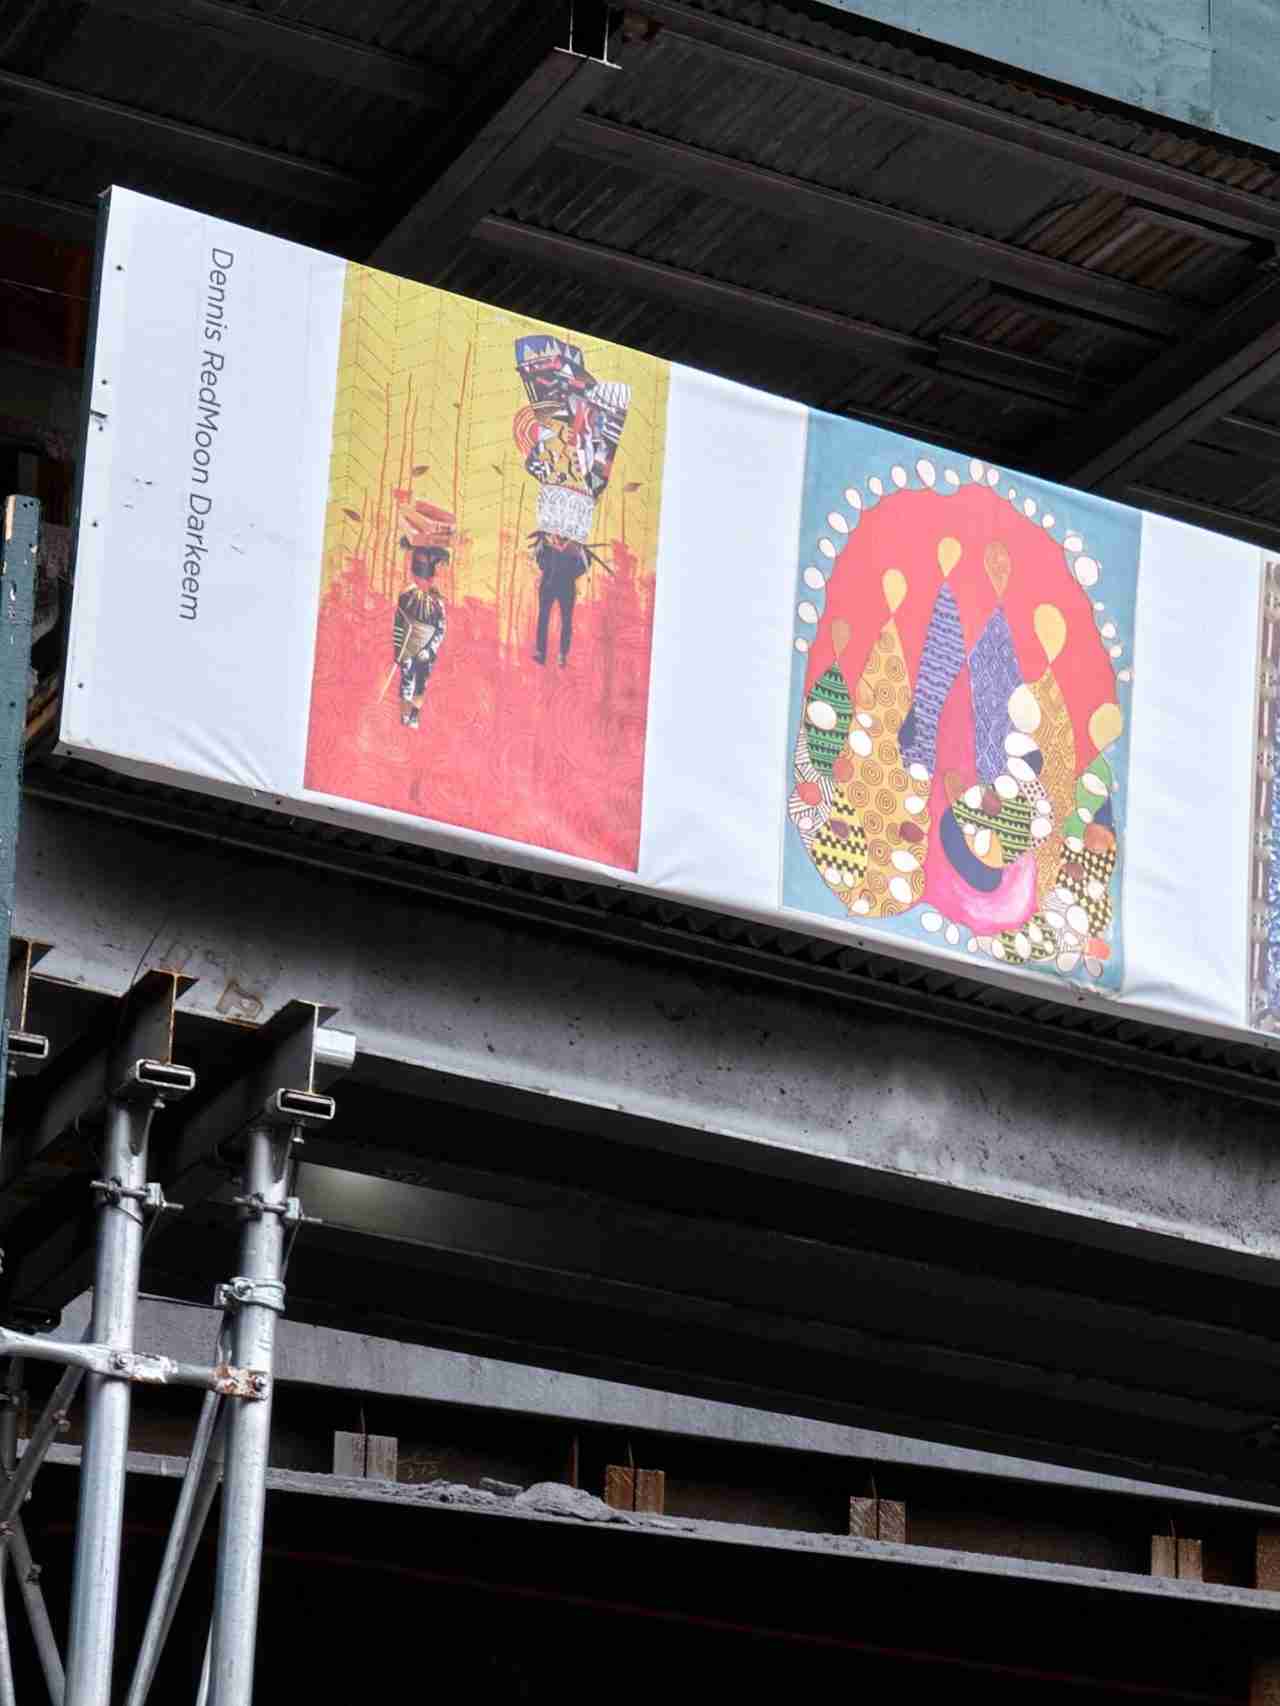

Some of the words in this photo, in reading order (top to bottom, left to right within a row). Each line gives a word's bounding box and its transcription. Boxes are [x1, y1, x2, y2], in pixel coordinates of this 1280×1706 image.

[204, 248, 234, 342] Dennis
[192, 350, 224, 484] RedMoon
[179, 493, 212, 620] Darkeem
